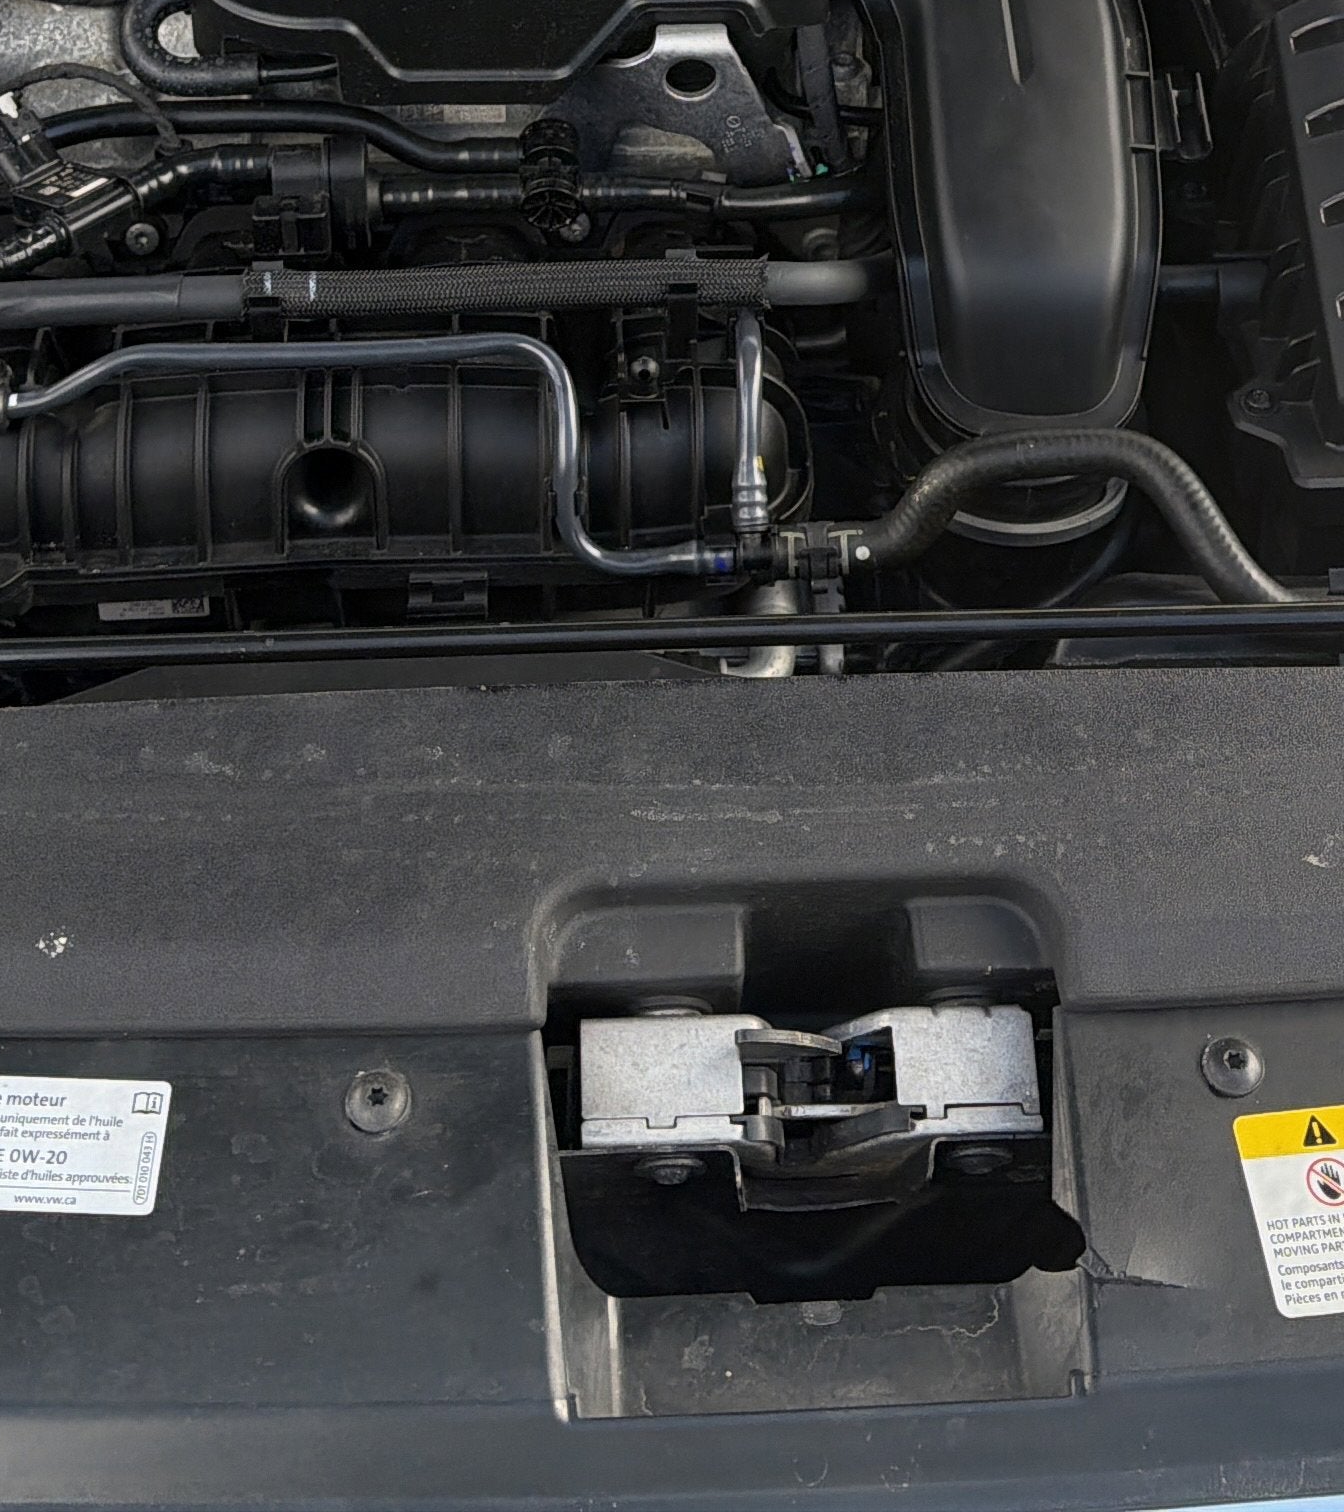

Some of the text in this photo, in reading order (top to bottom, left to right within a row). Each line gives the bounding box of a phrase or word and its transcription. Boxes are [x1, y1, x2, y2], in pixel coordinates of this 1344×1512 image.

[5, 1092, 67, 1107] moteur
[0, 1112, 70, 1126] uniquement
[71, 1114, 87, 1126] de
[88, 1114, 124, 1127] l'huile
[20, 1128, 101, 1141] expressément
[102, 1129, 110, 1141] à
[20, 1168, 64, 1181] d'huiles
[140, 1165, 150, 1182] 010
[13, 1194, 77, 1205] www.vw.ca
[137, 1185, 147, 1200] 701
[1266, 1218, 1288, 1231] HOT
[1291, 1214, 1326, 1228] PARTS
[1327, 1213, 1341, 1224] IN
[1272, 1243, 1319, 1258] MOVING
[1277, 1259, 1344, 1276] Composants
[1280, 1279, 1292, 1291] le
[1284, 1292, 1321, 1306] Pièces
[1323, 1291, 1338, 1301] en
